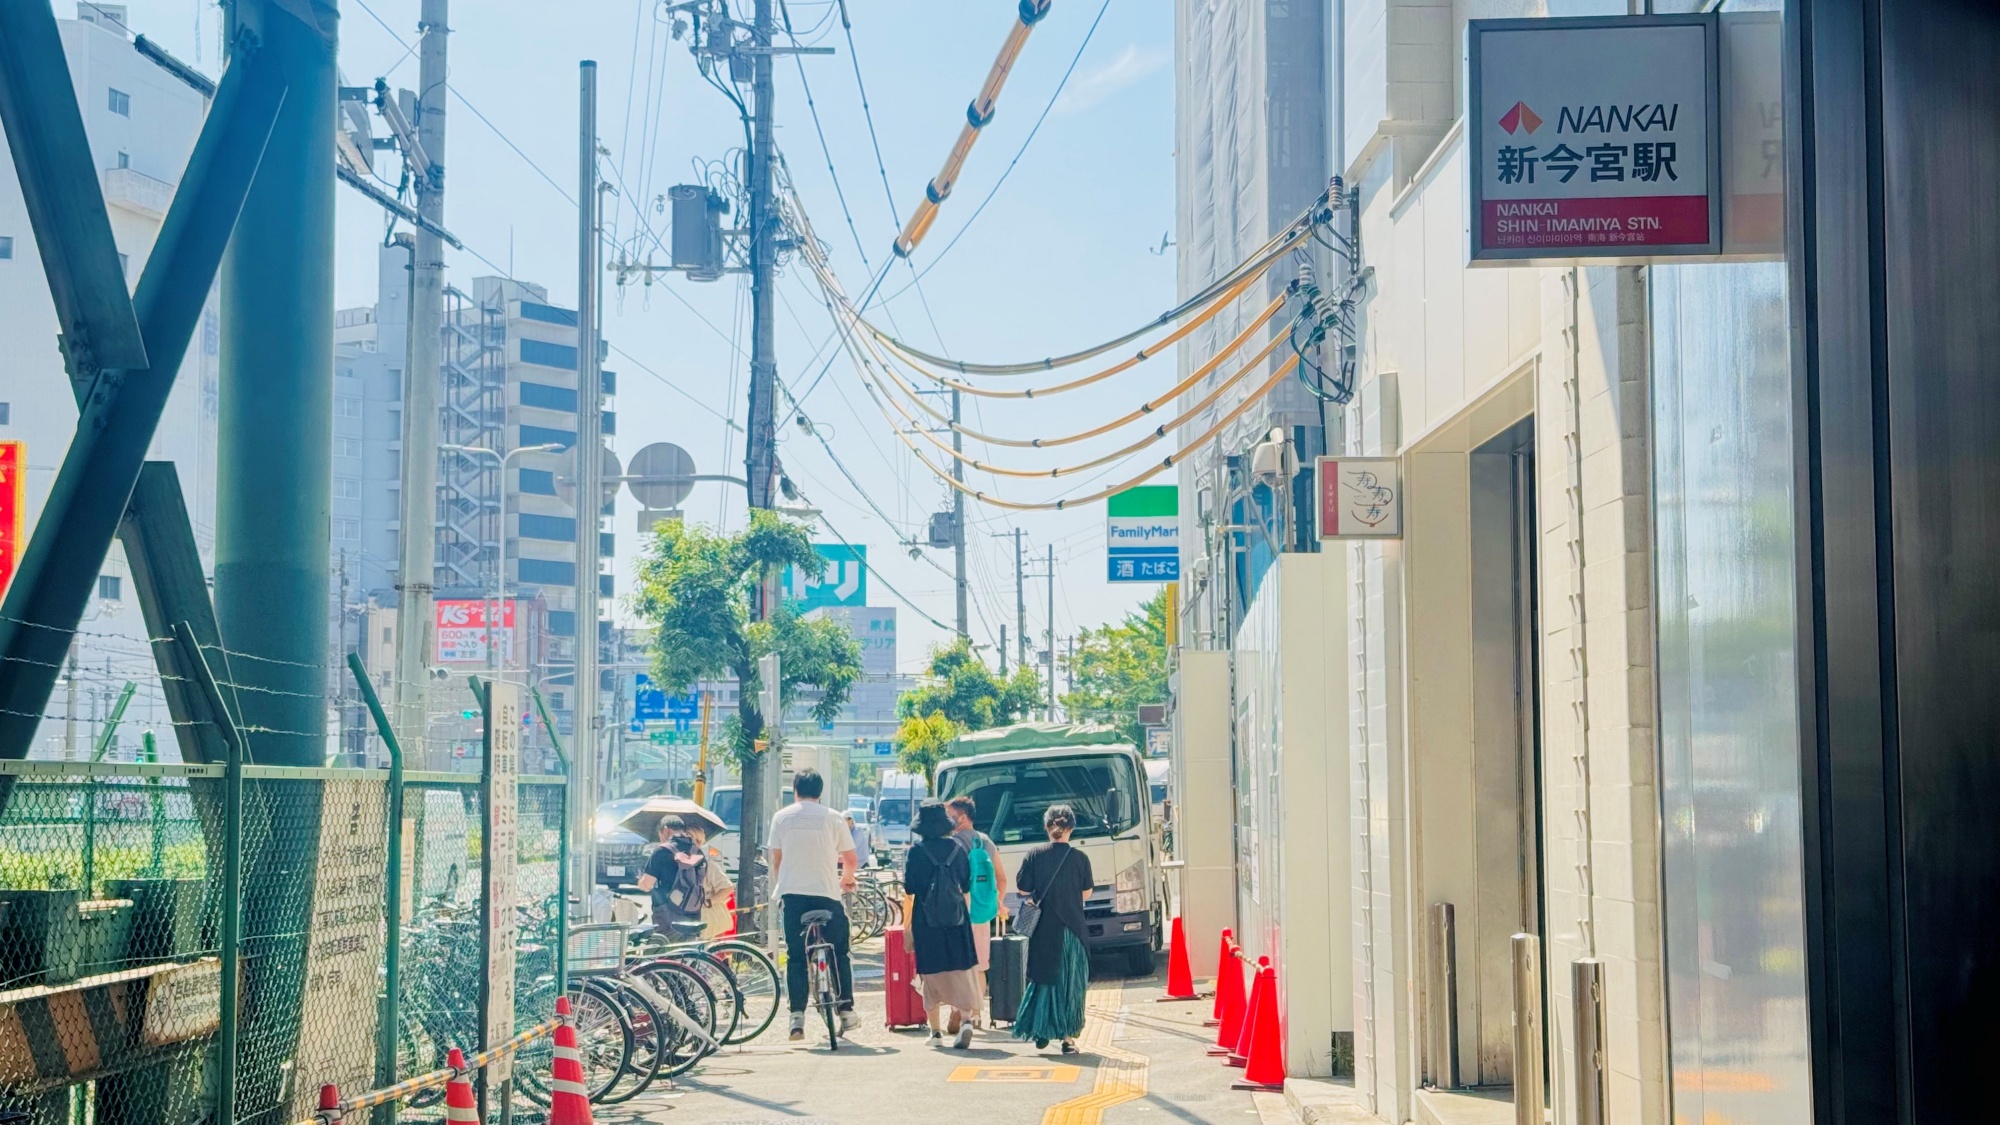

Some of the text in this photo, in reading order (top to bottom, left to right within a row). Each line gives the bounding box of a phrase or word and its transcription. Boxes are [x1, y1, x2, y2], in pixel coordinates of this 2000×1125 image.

[1557, 104, 1678, 134] NANKAI
[1497, 142, 1679, 185] 新今宮駅
[1496, 203, 1558, 216] NANKAI
[1497, 216, 1662, 233] SHIN-IMAMIYA STN.
[1497, 235, 1524, 244] 난카이
[1110, 525, 1179, 540] FamilyMart
[1116, 560, 1178, 577] 酒 たばこ
